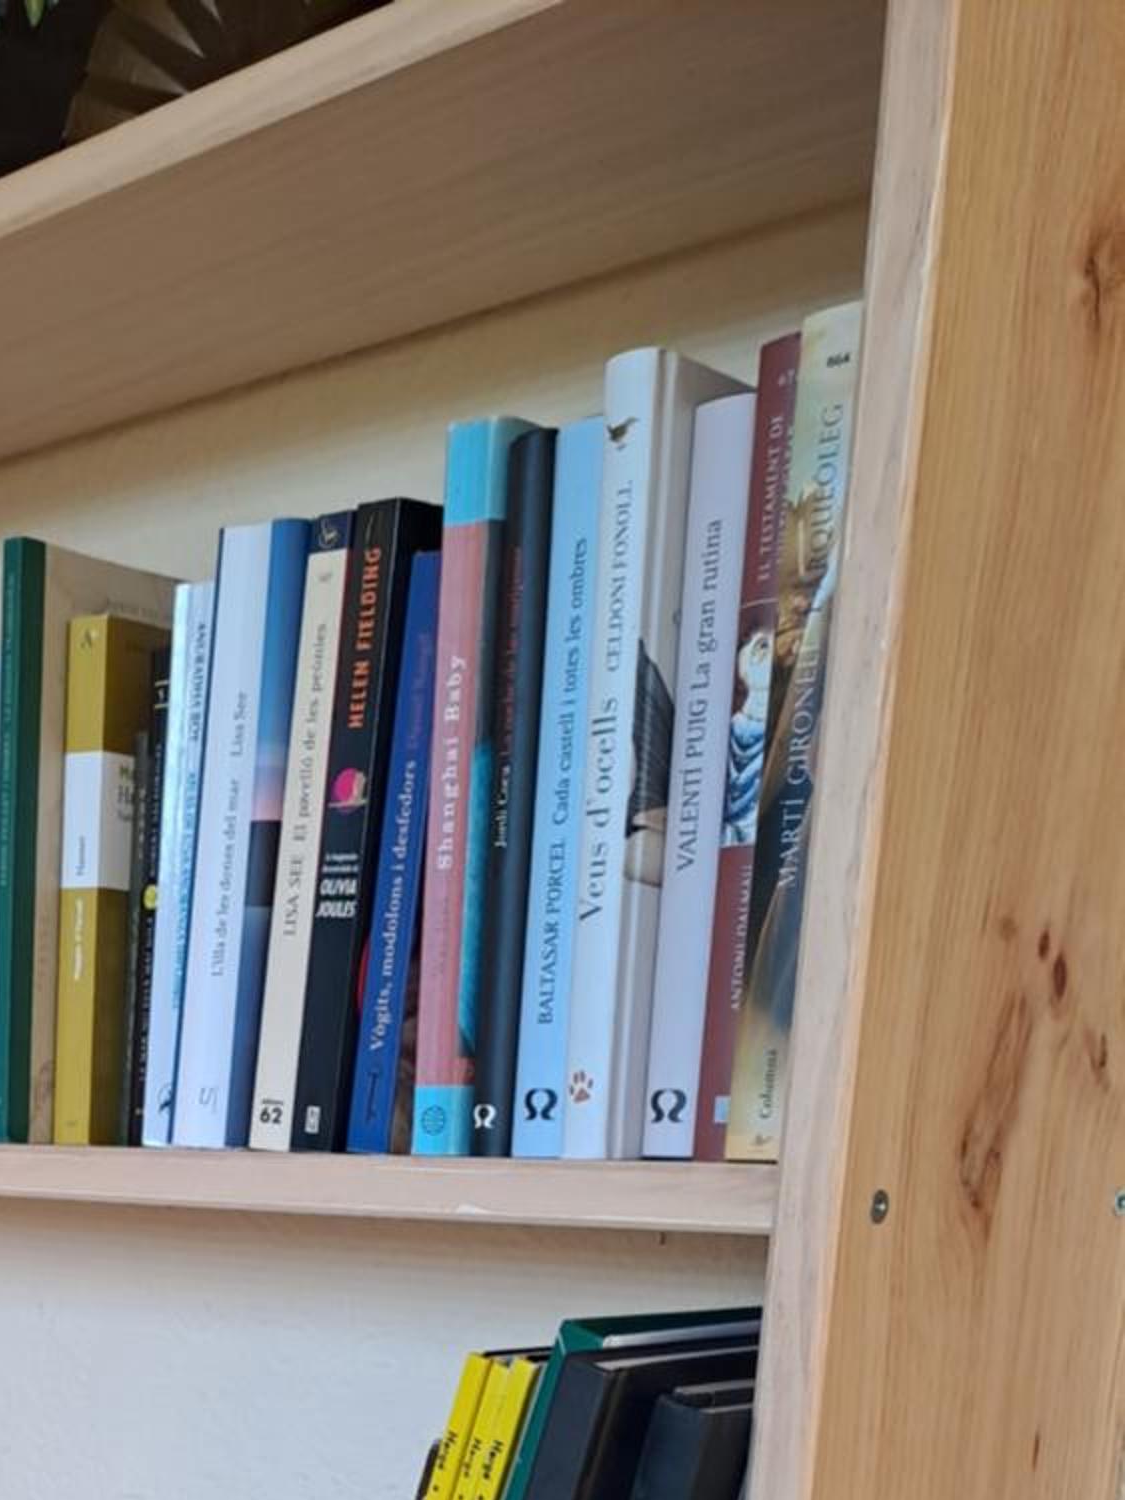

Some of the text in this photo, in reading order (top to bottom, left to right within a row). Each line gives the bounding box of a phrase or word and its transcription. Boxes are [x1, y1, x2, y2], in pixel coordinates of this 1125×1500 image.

[346, 546, 381, 729] HELEN FIELDING
[605, 575, 627, 673] CELDONI
[303, 729, 316, 751] de
[306, 697, 319, 721] les
[435, 653, 467, 871] Shanghai Baby
[675, 518, 723, 872] VALENTÍ PUIG La gran rutina
[776, 641, 820, 889] MARTÍ GIRONELL
[536, 536, 588, 1026] BALTASAR PORCEL Cada castell totes les ombres
[577, 693, 620, 922] Veus d'ocells
[282, 894, 300, 937] LISA
[288, 857, 304, 892] SEE
[259, 1106, 284, 1126] 62
